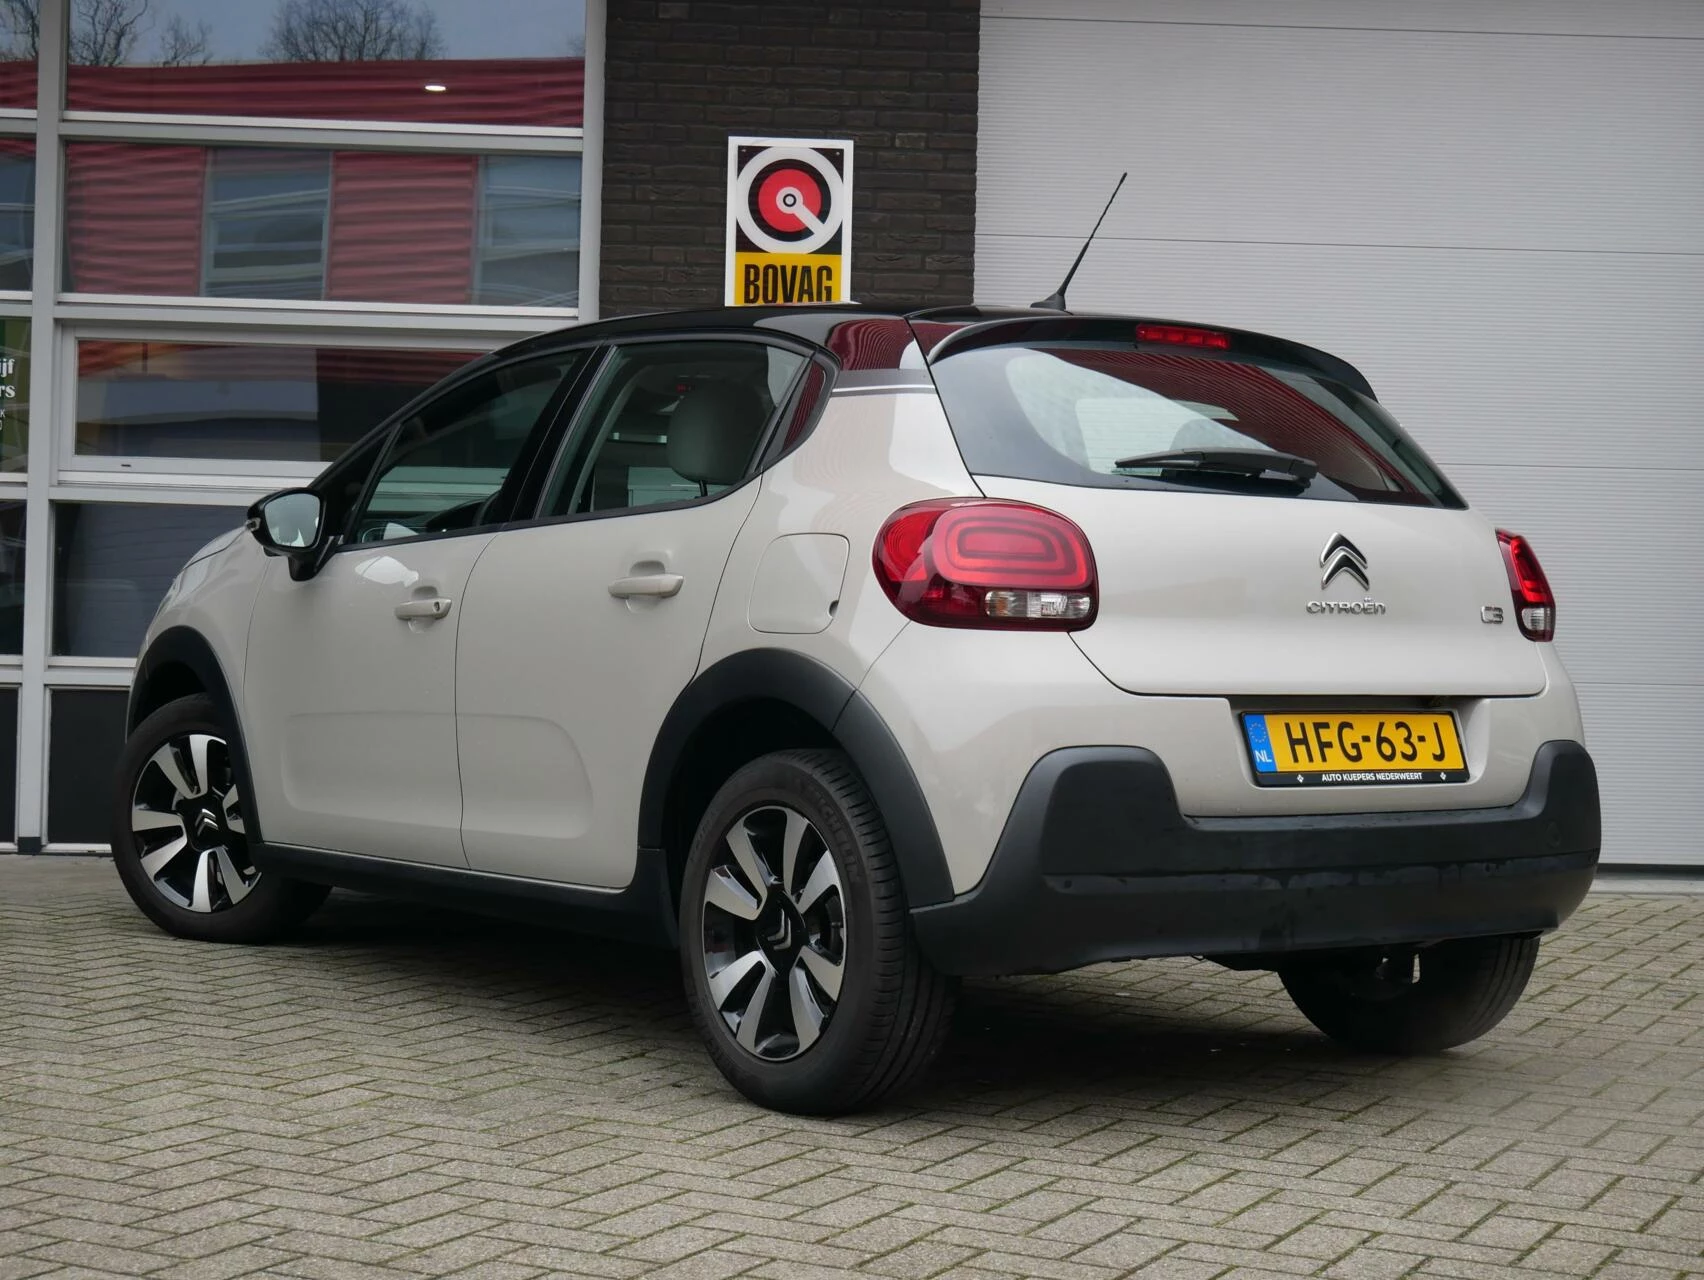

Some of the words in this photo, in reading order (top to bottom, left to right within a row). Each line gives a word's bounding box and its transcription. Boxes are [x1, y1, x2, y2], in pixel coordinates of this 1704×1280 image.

[744, 264, 832, 303] BOVAG
[1481, 605, 1504, 624] C3
[1284, 721, 1446, 763] HFG-63-J
[1255, 749, 1272, 763] NL
[1321, 773, 1342, 782] AUTO
[1376, 771, 1423, 781] NEDERWEERT
